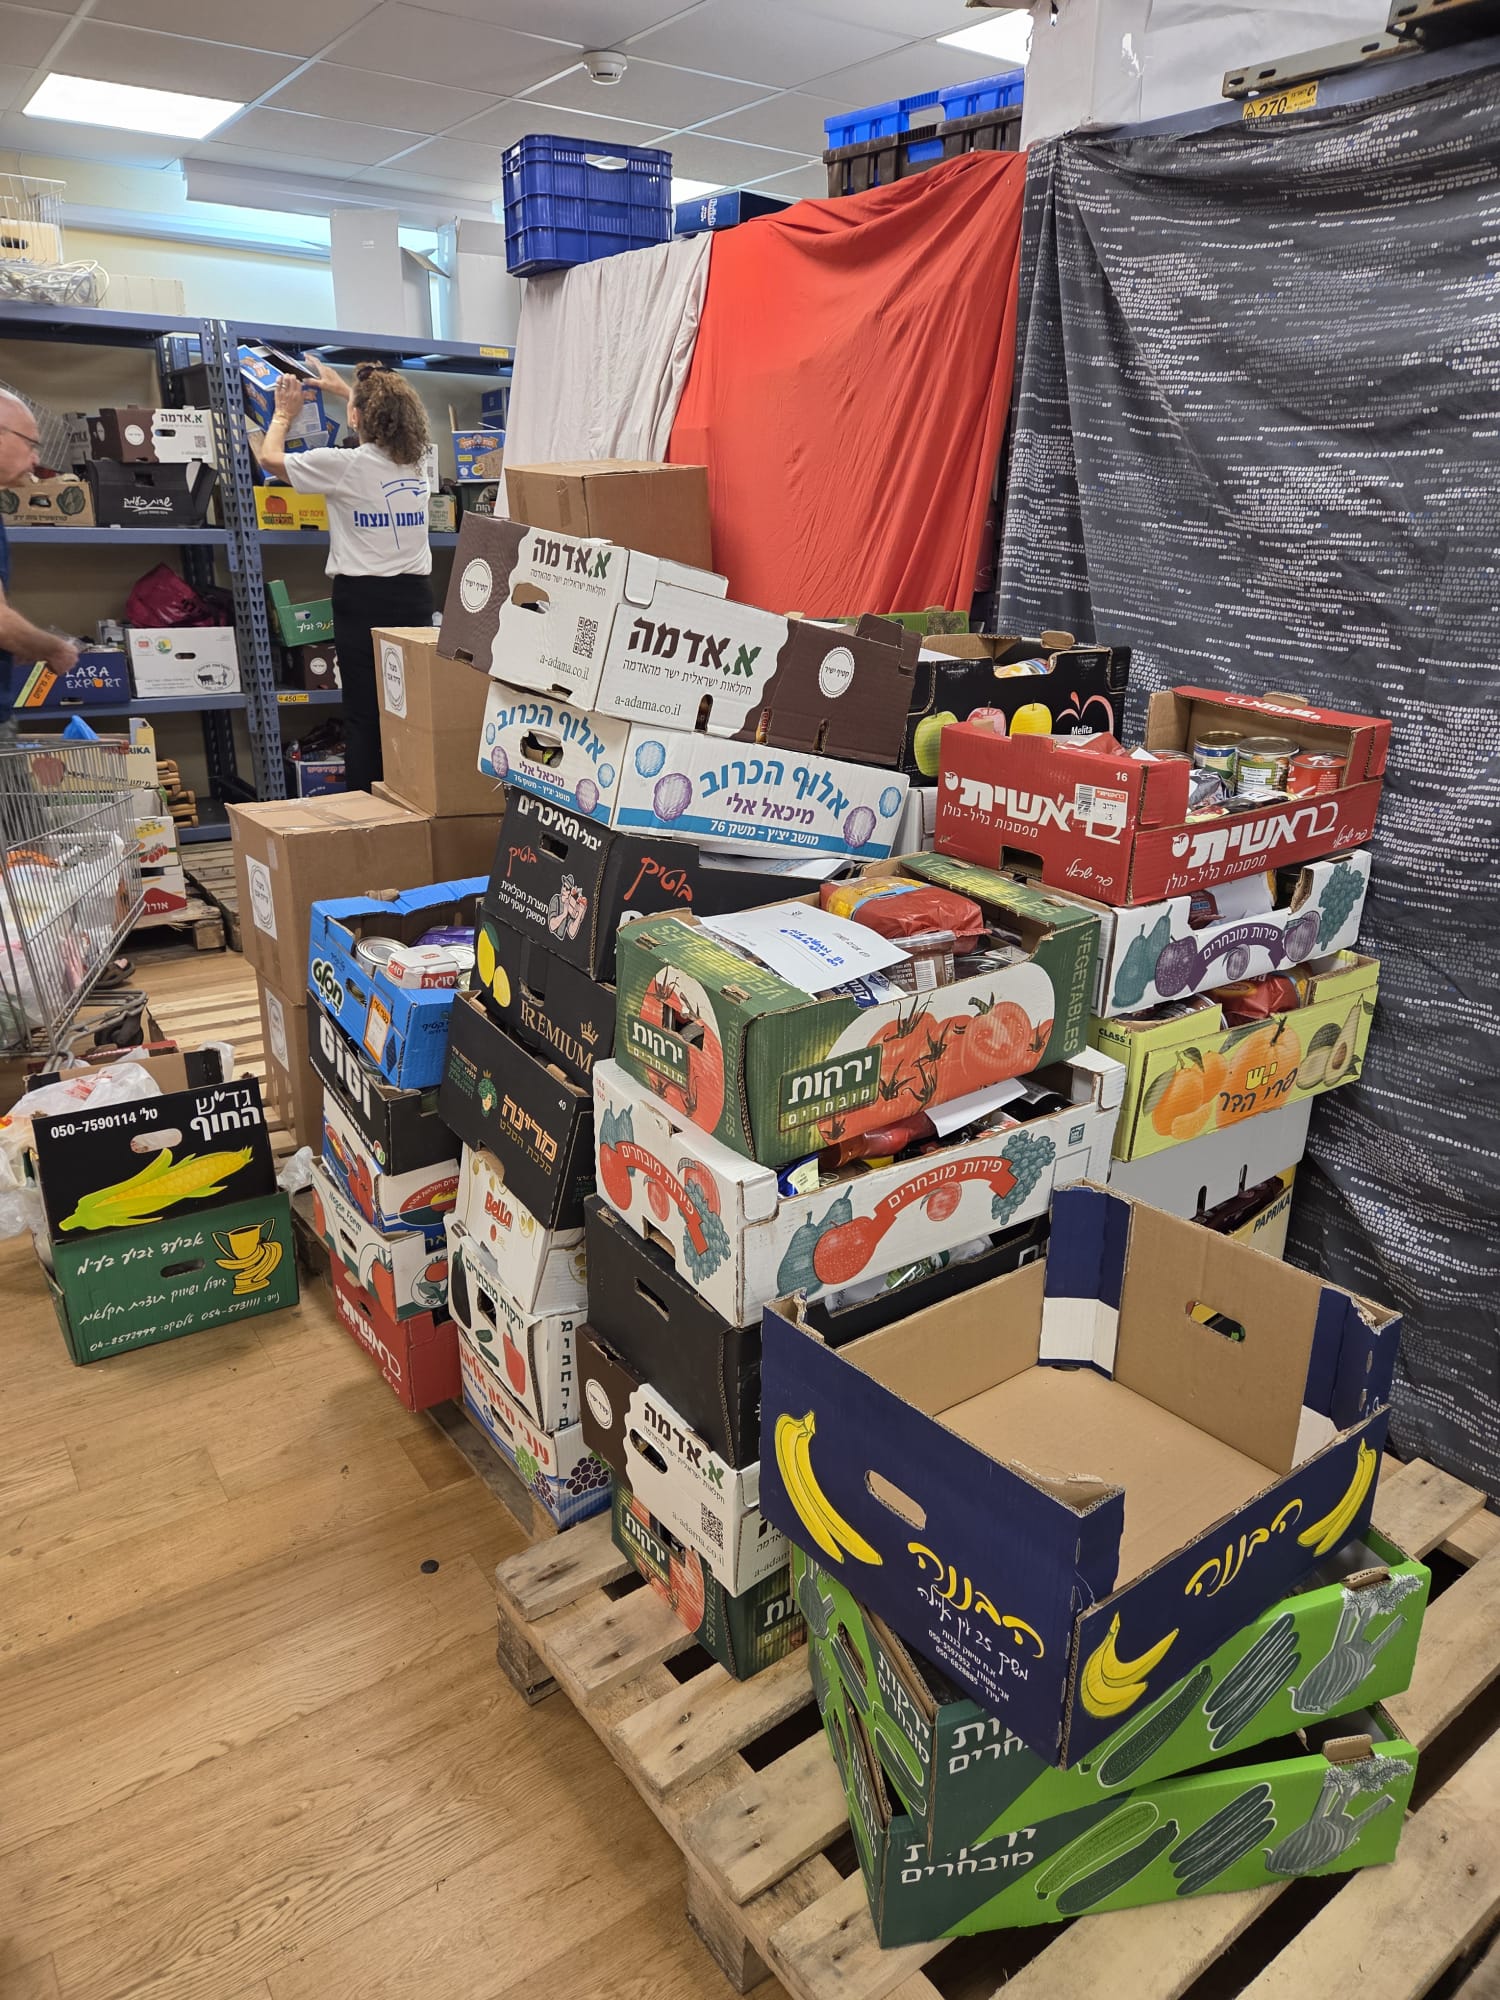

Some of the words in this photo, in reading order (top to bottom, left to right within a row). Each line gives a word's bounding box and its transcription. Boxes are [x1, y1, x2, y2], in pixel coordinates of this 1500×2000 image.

[1259, 96, 1287, 118] 270
[354, 510, 389, 527] ננצח!
[396, 511, 425, 527] אנחנו
[533, 537, 612, 580] א.אדמה
[530, 568, 551, 582] מהאדמה
[553, 574, 563, 584] ישר
[563, 577, 585, 592] ישראלית
[586, 582, 606, 596] חקלאות
[628, 617, 762, 678] א.אדמה
[539, 653, 589, 681] a-adama.co.il
[622, 658, 661, 676] מהאדמה
[664, 668, 680, 681] ישר
[682, 671, 718, 690] ישראלית
[824, 666, 837, 676] ישיר
[837, 668, 850, 680] קטיף
[719, 679, 752, 695] חקלאות
[496, 703, 553, 731] הכרוב
[614, 694, 682, 717] a-adama.co.il
[559, 711, 606, 764] אלוף
[1071, 726, 1093, 738] Melita
[519, 760, 535, 777] אלי
[537, 766, 564, 788] מיכאל
[700, 759, 785, 798] הכרוב
[1115, 771, 1128, 782] 16
[726, 792, 754, 816] אלי
[792, 766, 850, 820] אלוף
[517, 794, 579, 840] האיכרים
[761, 797, 815, 825] מיכאל
[579, 827, 602, 851] יבולי
[710, 819, 725, 832] 76
[727, 823, 755, 838] משק
[766, 827, 789, 845] יציץ
[791, 831, 819, 846] מושב
[1187, 801, 1339, 869] בראשית
[507, 845, 537, 878] בוטיק
[500, 880, 526, 901] חקלאית
[623, 857, 695, 902] בוטיק
[498, 891, 510, 905] עזה
[510, 899, 525, 914] עוטף
[527, 895, 549, 914] תוצרת
[525, 907, 547, 926] ממשקי
[1202, 928, 1248, 962] מובחרים
[1249, 924, 1280, 943] פירות
[423, 971, 457, 989] סוגת
[1063, 927, 1094, 1053] VEGETABLES
[520, 999, 594, 1075] PREMIUM
[632, 1020, 684, 1064] ירקות
[1098, 1027, 1127, 1044] CLASS
[632, 1046, 686, 1087] מובחרים
[726, 1016, 737, 1139] VEGETABLES
[788, 1054, 873, 1104] ירקות
[1264, 1067, 1298, 1100] פרי
[558, 1099, 567, 1111] 40
[788, 1088, 871, 1126] מובחרים
[1219, 1090, 1256, 1114] הדר
[50, 1112, 137, 1138] 050-7590114
[190, 1105, 261, 1142] החוף
[499, 1118, 524, 1148] הסלט
[502, 1094, 558, 1162] מרינה
[527, 1144, 552, 1176] מלכת
[621, 1143, 662, 1176] מובחרים
[961, 1157, 1003, 1175] פירות
[665, 1172, 694, 1215] פירות
[886, 1163, 957, 1210] מובחרים
[1252, 1195, 1292, 1234] PAPRIKA
[466, 1257, 499, 1302] מובחרים
[500, 1298, 524, 1330] ירקות
[489, 1387, 516, 1426] משק
[519, 1420, 549, 1466] ענבי
[643, 1401, 725, 1490] א.אדמה
[625, 1512, 665, 1563] ירקות
[757, 1533, 785, 1553] אדמה
[1184, 1498, 1303, 1598] הבננה
[705, 1580, 717, 1647] ETABLES
[907, 1542, 1045, 1659] הבננה
[941, 1627, 962, 1649] בננות
[976, 1630, 993, 1652] 25
[962, 1646, 982, 1665] שיווק
[998, 1652, 1030, 1681] משק
[878, 1650, 930, 1739] ירקות
[877, 1669, 930, 1763] מובחרים
[900, 1851, 1035, 1885] מובחרים
